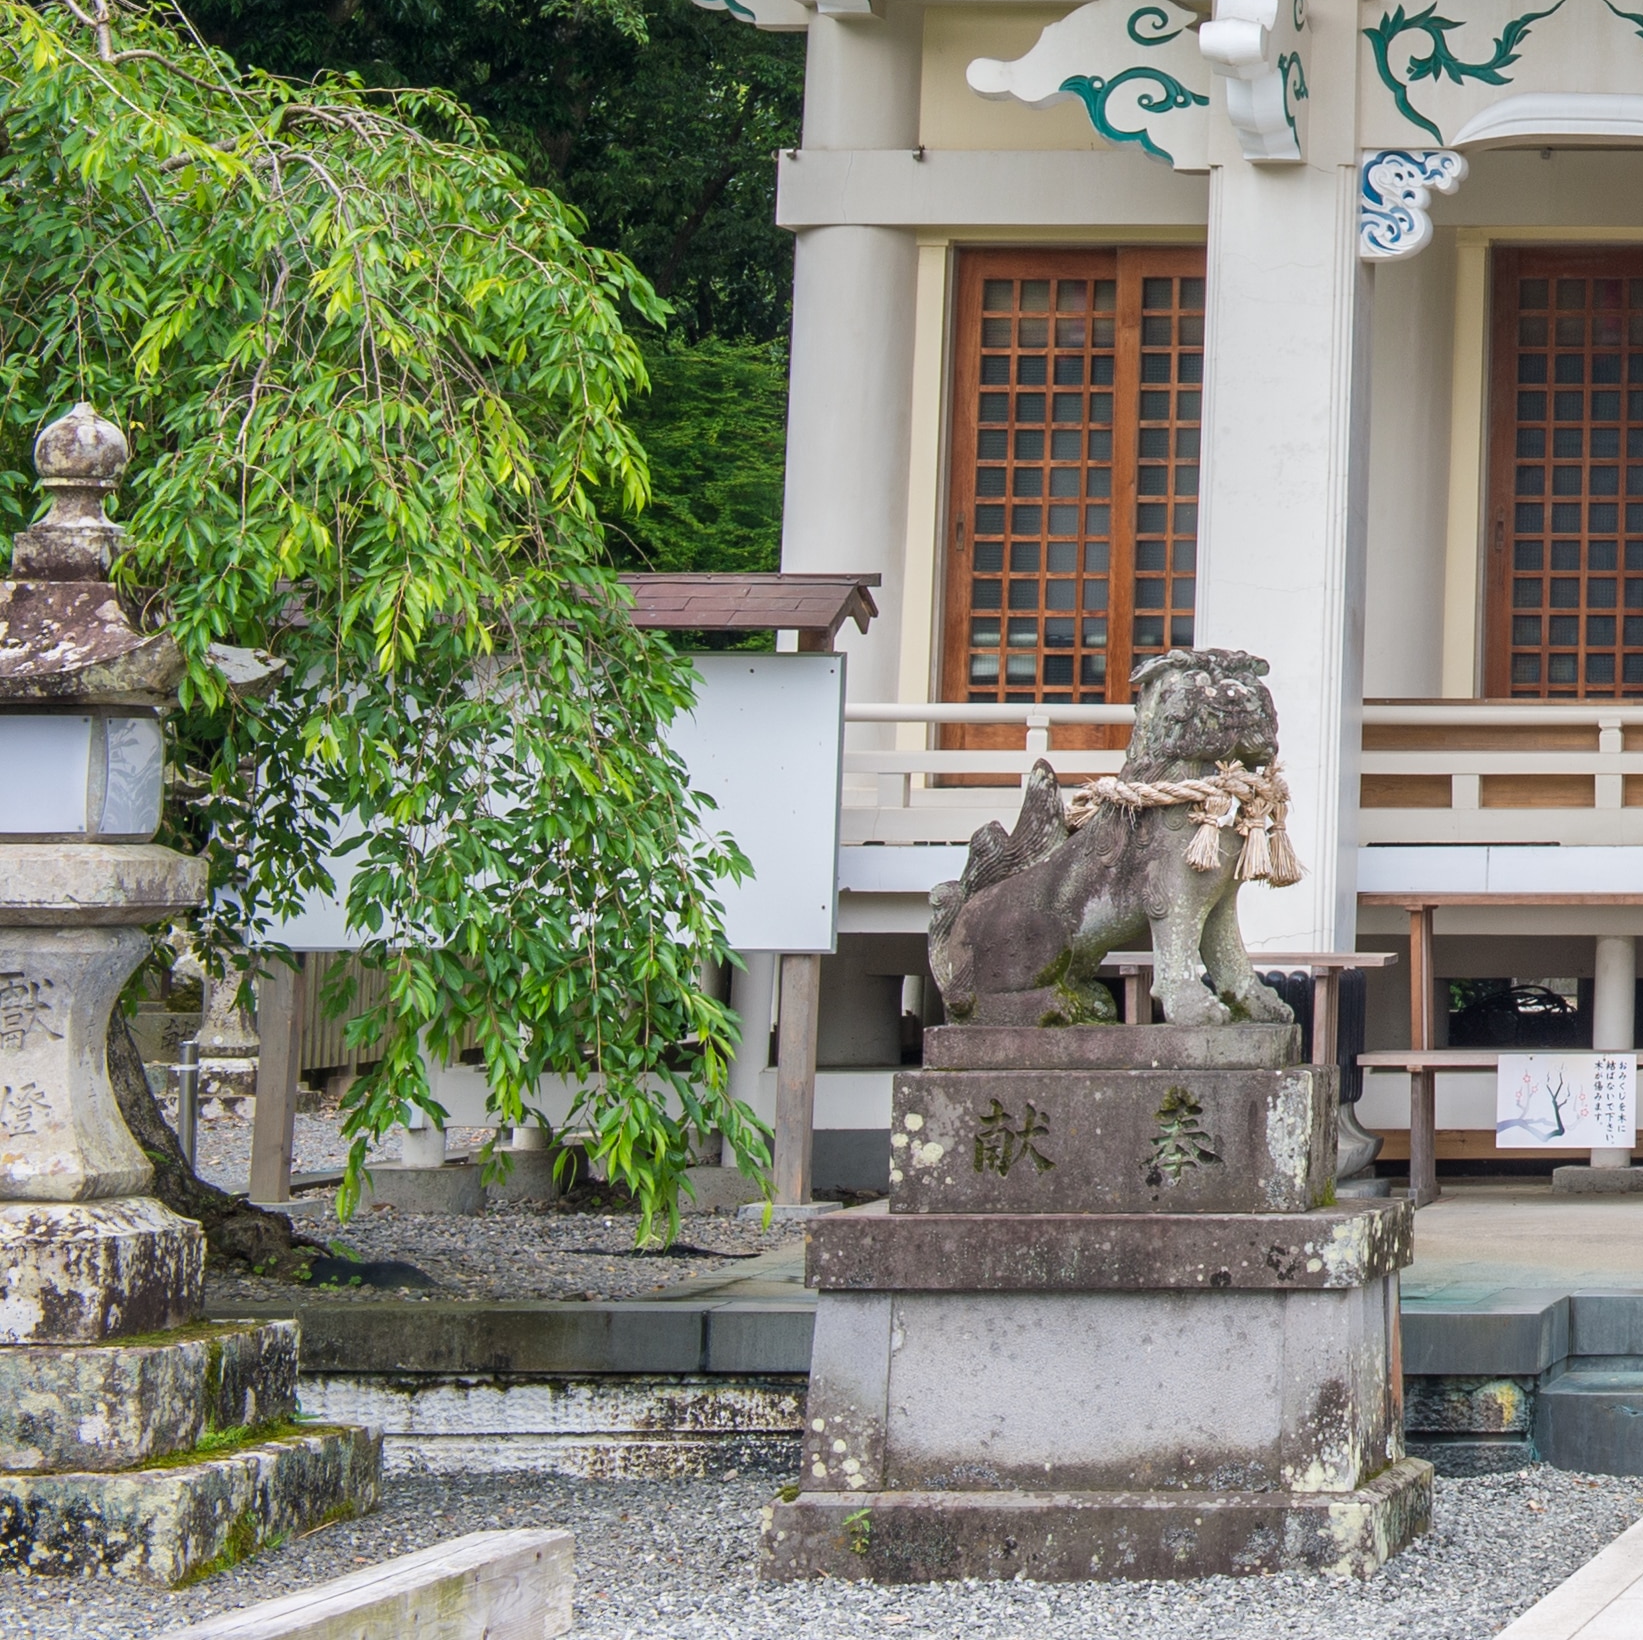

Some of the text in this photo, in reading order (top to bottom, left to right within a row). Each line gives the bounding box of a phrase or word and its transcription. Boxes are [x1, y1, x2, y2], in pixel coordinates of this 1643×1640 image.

[1618, 1061, 1628, 1134] おみくじを木に
